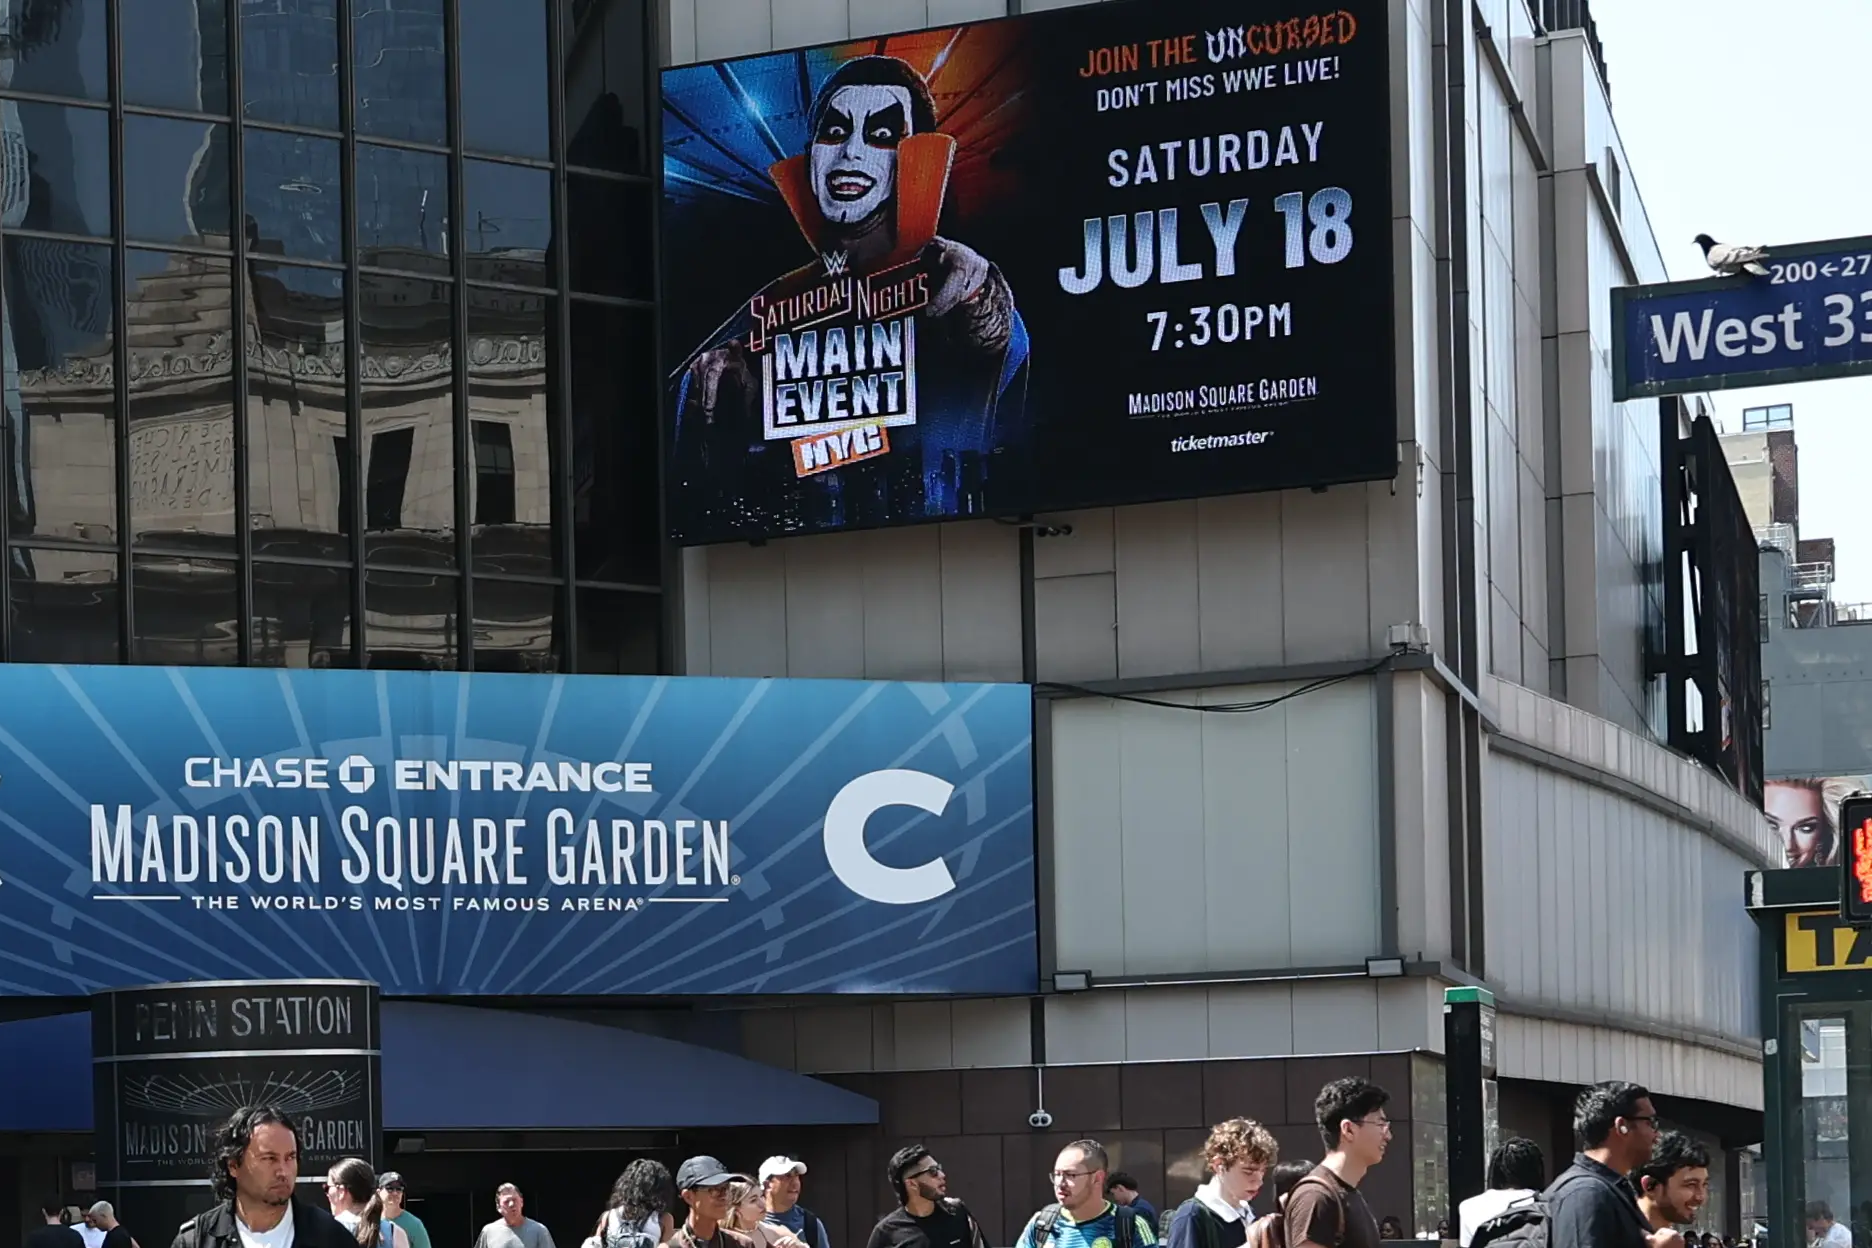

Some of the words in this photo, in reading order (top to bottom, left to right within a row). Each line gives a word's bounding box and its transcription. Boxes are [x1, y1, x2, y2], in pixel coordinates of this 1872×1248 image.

[1079, 48, 1139, 78] JOIN
[1146, 35, 1197, 67] THE
[1205, 9, 1357, 64] UNCURSED
[1096, 81, 1160, 112] DON'T
[1165, 74, 1215, 102] MISS
[1223, 65, 1277, 94] WWE
[1284, 56, 1341, 86] LIVE!
[1107, 121, 1324, 188] SATURDAY
[1058, 198, 1249, 295] JULY
[1274, 187, 1354, 269] 18
[1769, 261, 1817, 285] 200
[748, 277, 852, 350] SATURDAY
[1147, 303, 1292, 351] 7:30PM
[1650, 302, 1804, 364] West
[774, 321, 903, 381] MAIN
[776, 371, 905, 426] EVENT
[800, 424, 884, 471] NYC
[1170, 430, 1269, 453] ticketmaster
[184, 756, 331, 790] CHASE
[394, 760, 653, 793] ENTRANCE
[91, 804, 321, 884] MADISON
[340, 805, 528, 891] SQUARE
[823, 768, 957, 904] C
[192, 896, 239, 910] THE
[251, 895, 363, 911] WORLD'S
[374, 896, 442, 912] MOST
[453, 897, 550, 912] FAMOUS
[561, 897, 640, 913] ARENA
[135, 1000, 217, 1041] PENN
[231, 995, 353, 1037] STATION
